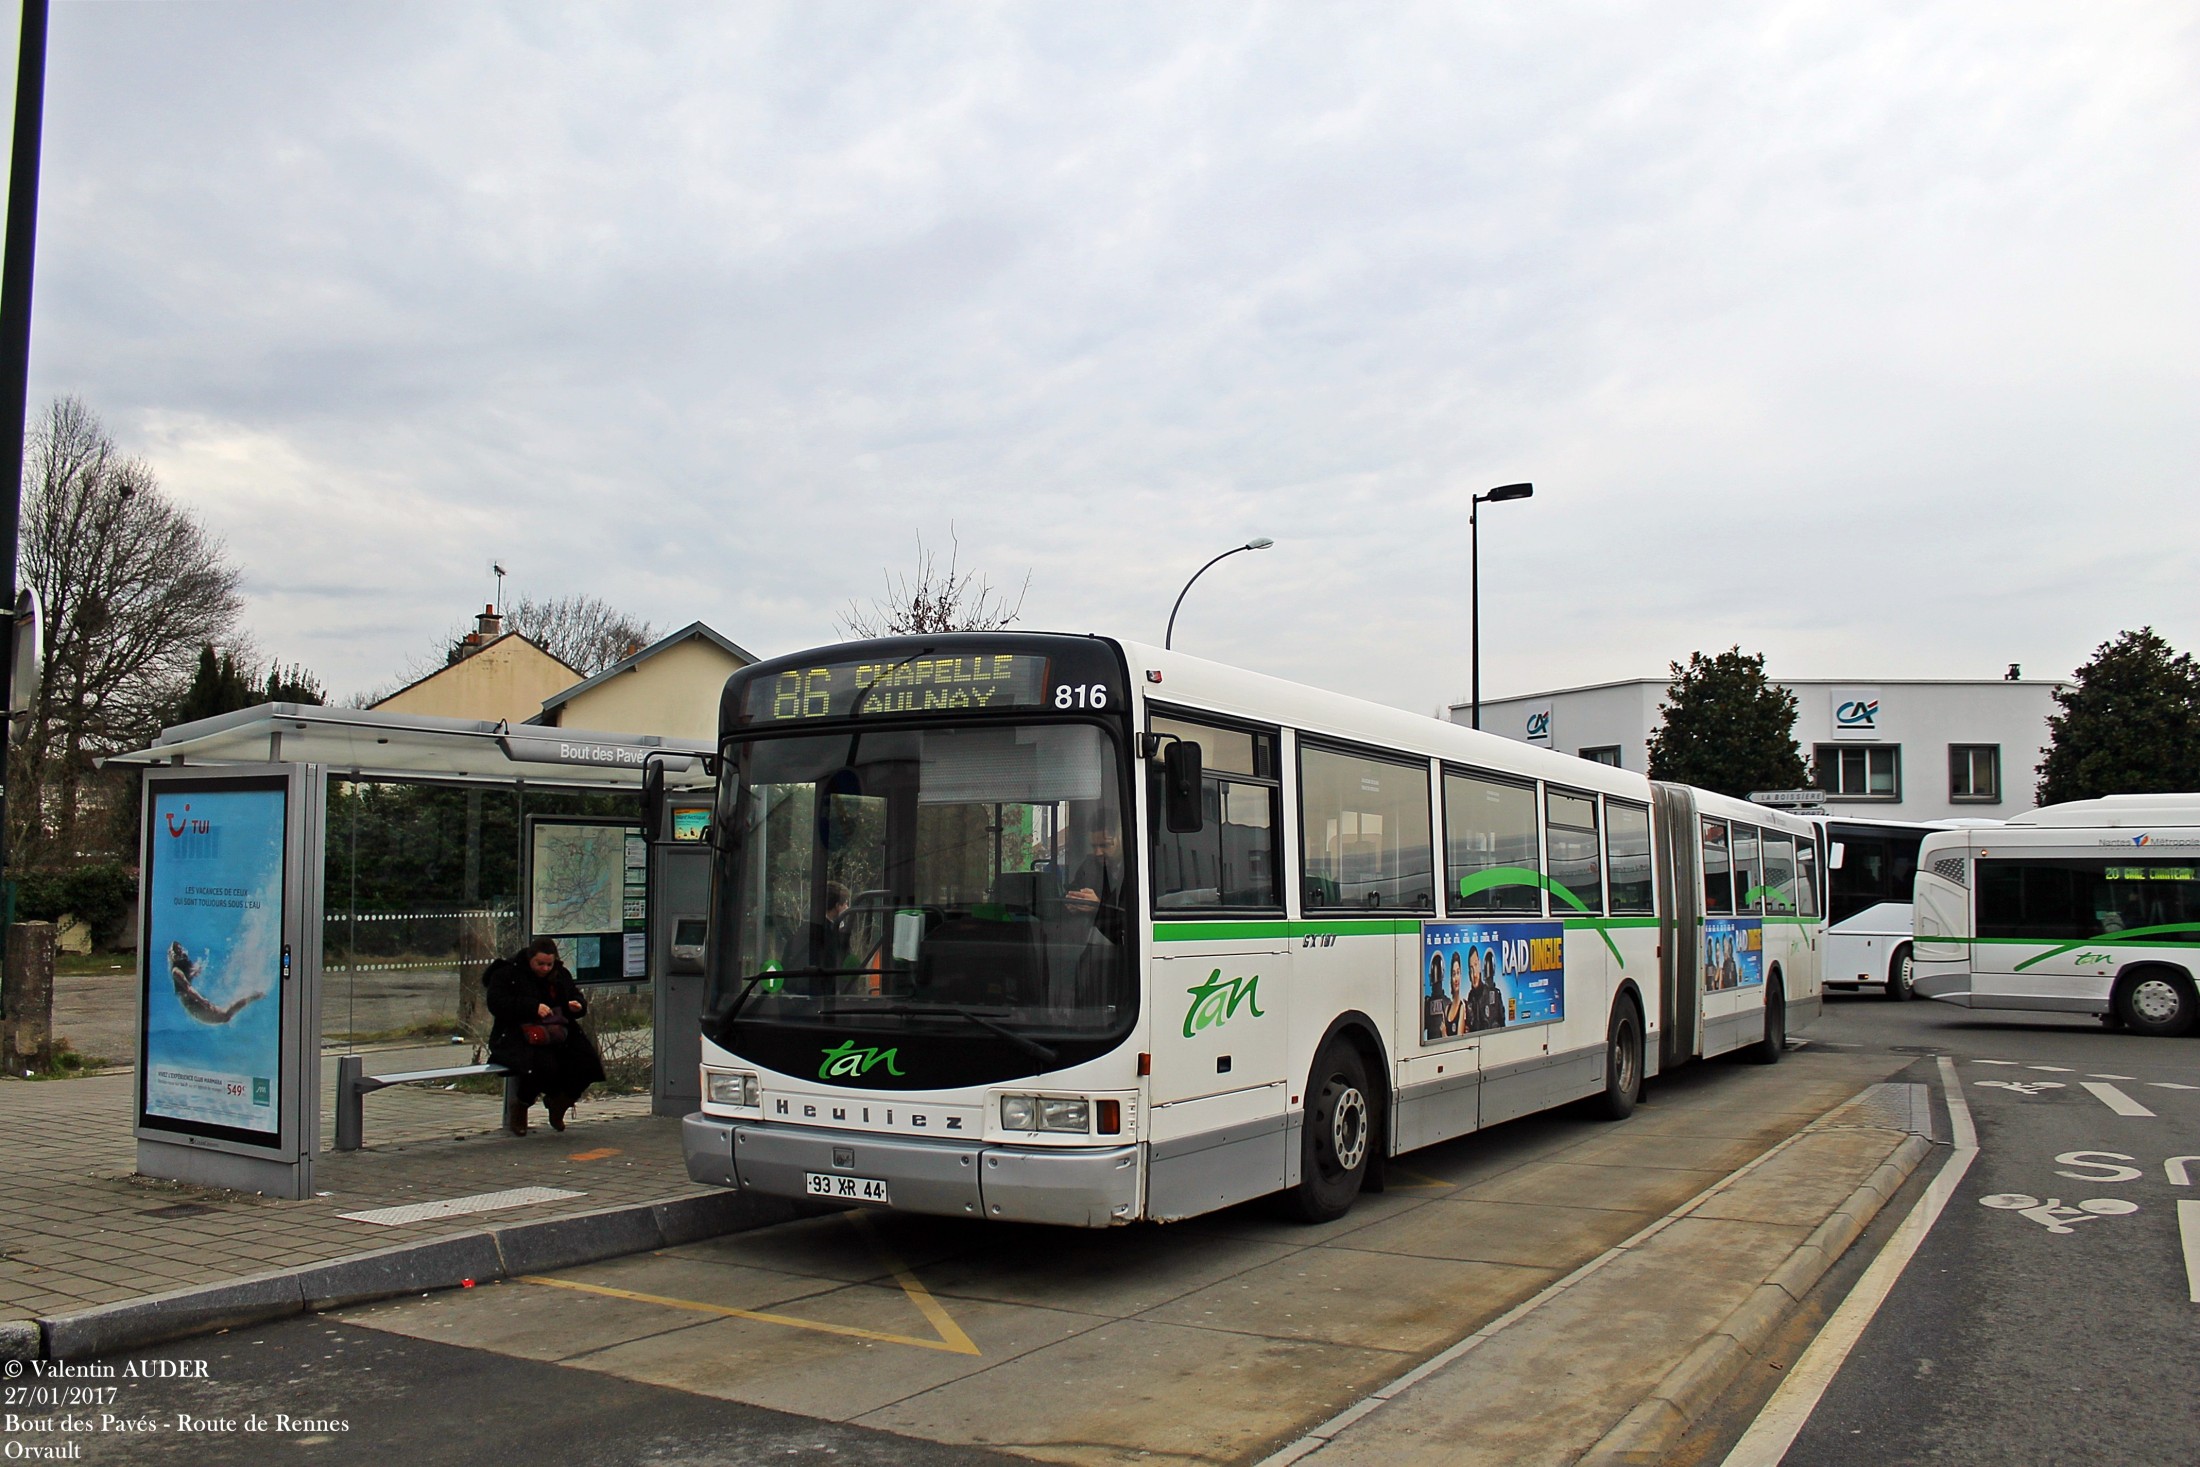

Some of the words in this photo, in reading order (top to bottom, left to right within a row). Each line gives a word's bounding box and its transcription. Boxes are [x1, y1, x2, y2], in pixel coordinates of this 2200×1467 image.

[774, 668, 831, 720] 86
[854, 654, 1013, 689] CHAPELLE
[1054, 684, 1108, 709] 816
[863, 685, 996, 714] AULNAY
[560, 743, 590, 760] Bout
[591, 746, 614, 762] des
[191, 819, 210, 835] TUI
[2098, 838, 2132, 847] Nantes
[2105, 867, 2120, 880] 20
[173, 897, 183, 906] QUI
[184, 897, 197, 906] SONT
[198, 898, 227, 908] TOUJOURS
[228, 899, 244, 909] SOUS
[244, 900, 261, 910] L'EAU
[185, 886, 195, 895] LES
[196, 886, 223, 896] VACANCES
[224, 888, 233, 896] DE
[233, 888, 249, 897] CEUX
[1501, 938, 1530, 979] RAID
[1529, 937, 1563, 972] DINGUE
[2074, 951, 2114, 966] tan
[1182, 968, 1265, 1039] tan
[818, 1039, 906, 1080] tan
[776, 1098, 963, 1130] Heuliez
[813, 1175, 831, 1194] 93
[838, 1178, 857, 1197] XR
[863, 1181, 882, 1199] 44
